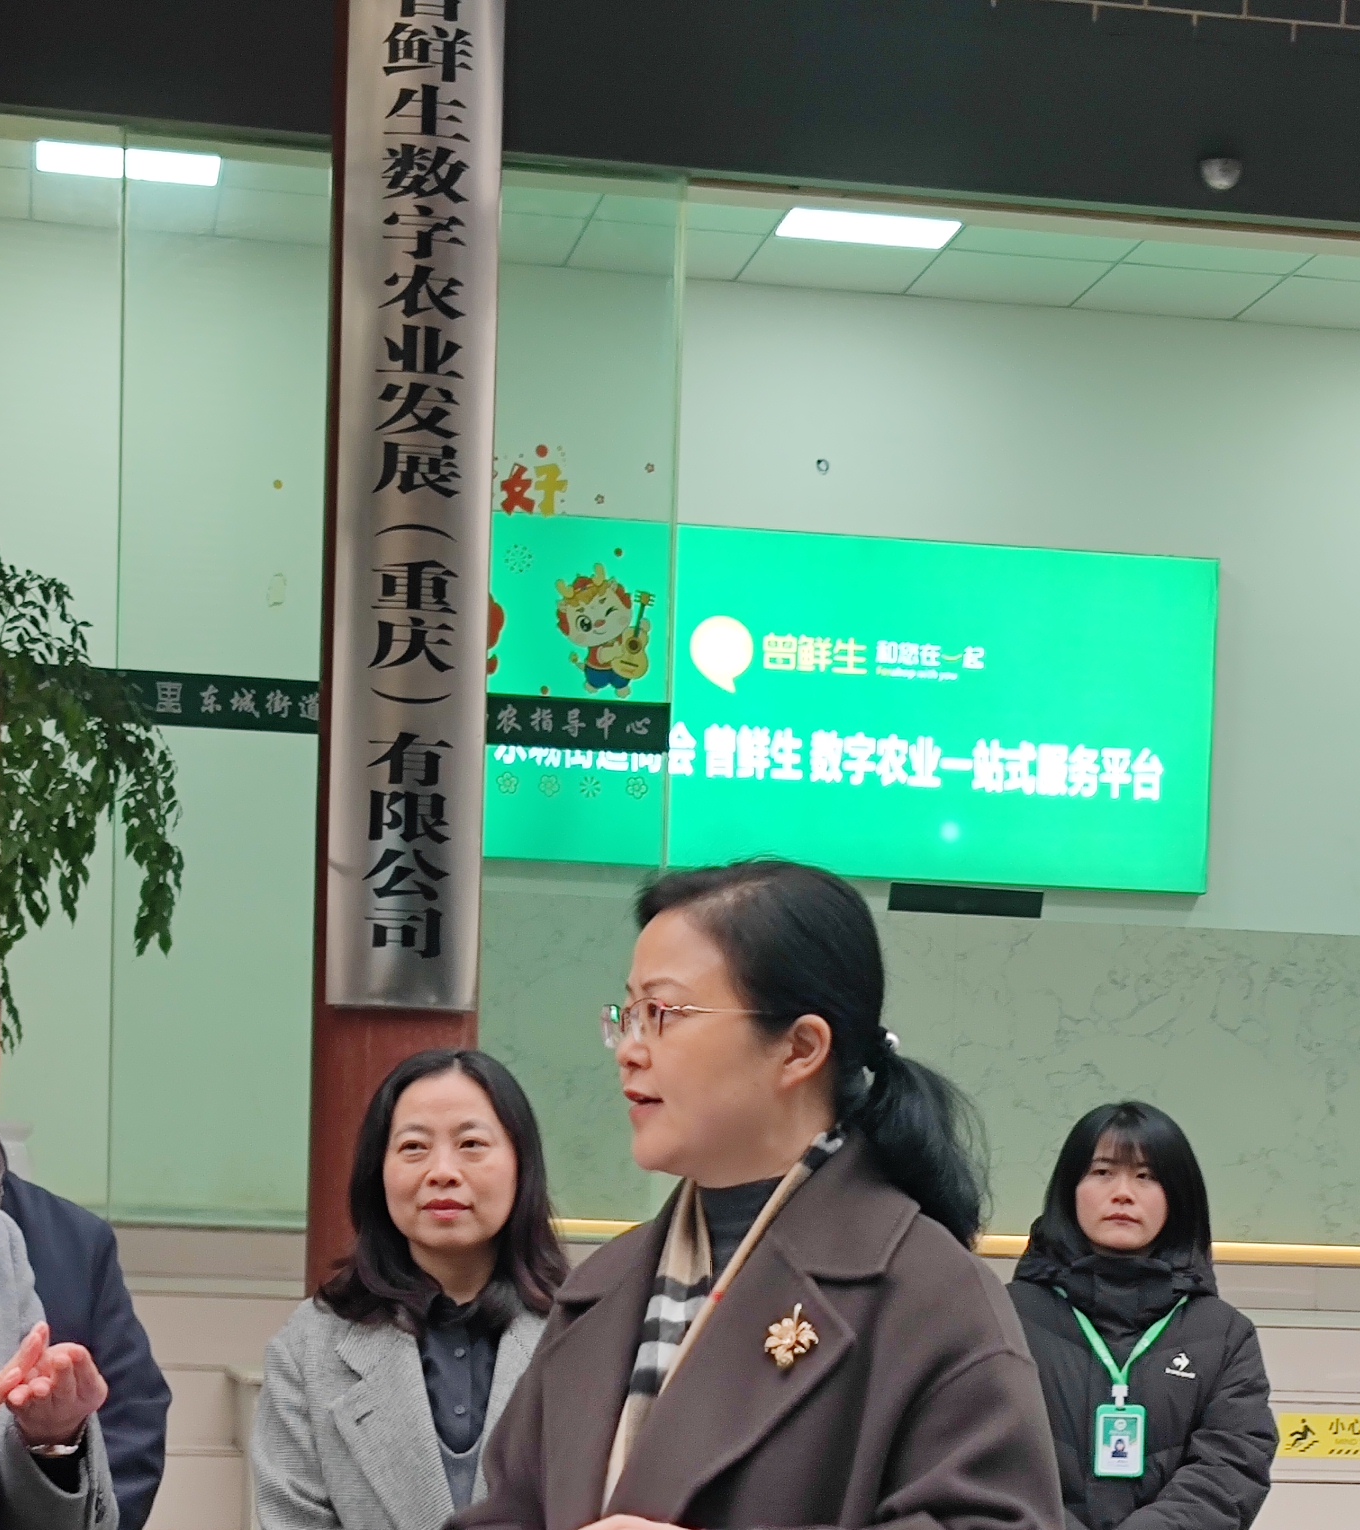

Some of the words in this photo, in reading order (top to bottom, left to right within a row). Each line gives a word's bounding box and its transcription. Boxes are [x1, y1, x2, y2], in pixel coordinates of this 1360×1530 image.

[762, 632, 869, 675] 曾鲜生
[703, 723, 803, 782] 曾鲜生
[809, 729, 1165, 802] 数字农业一站式服务平台
